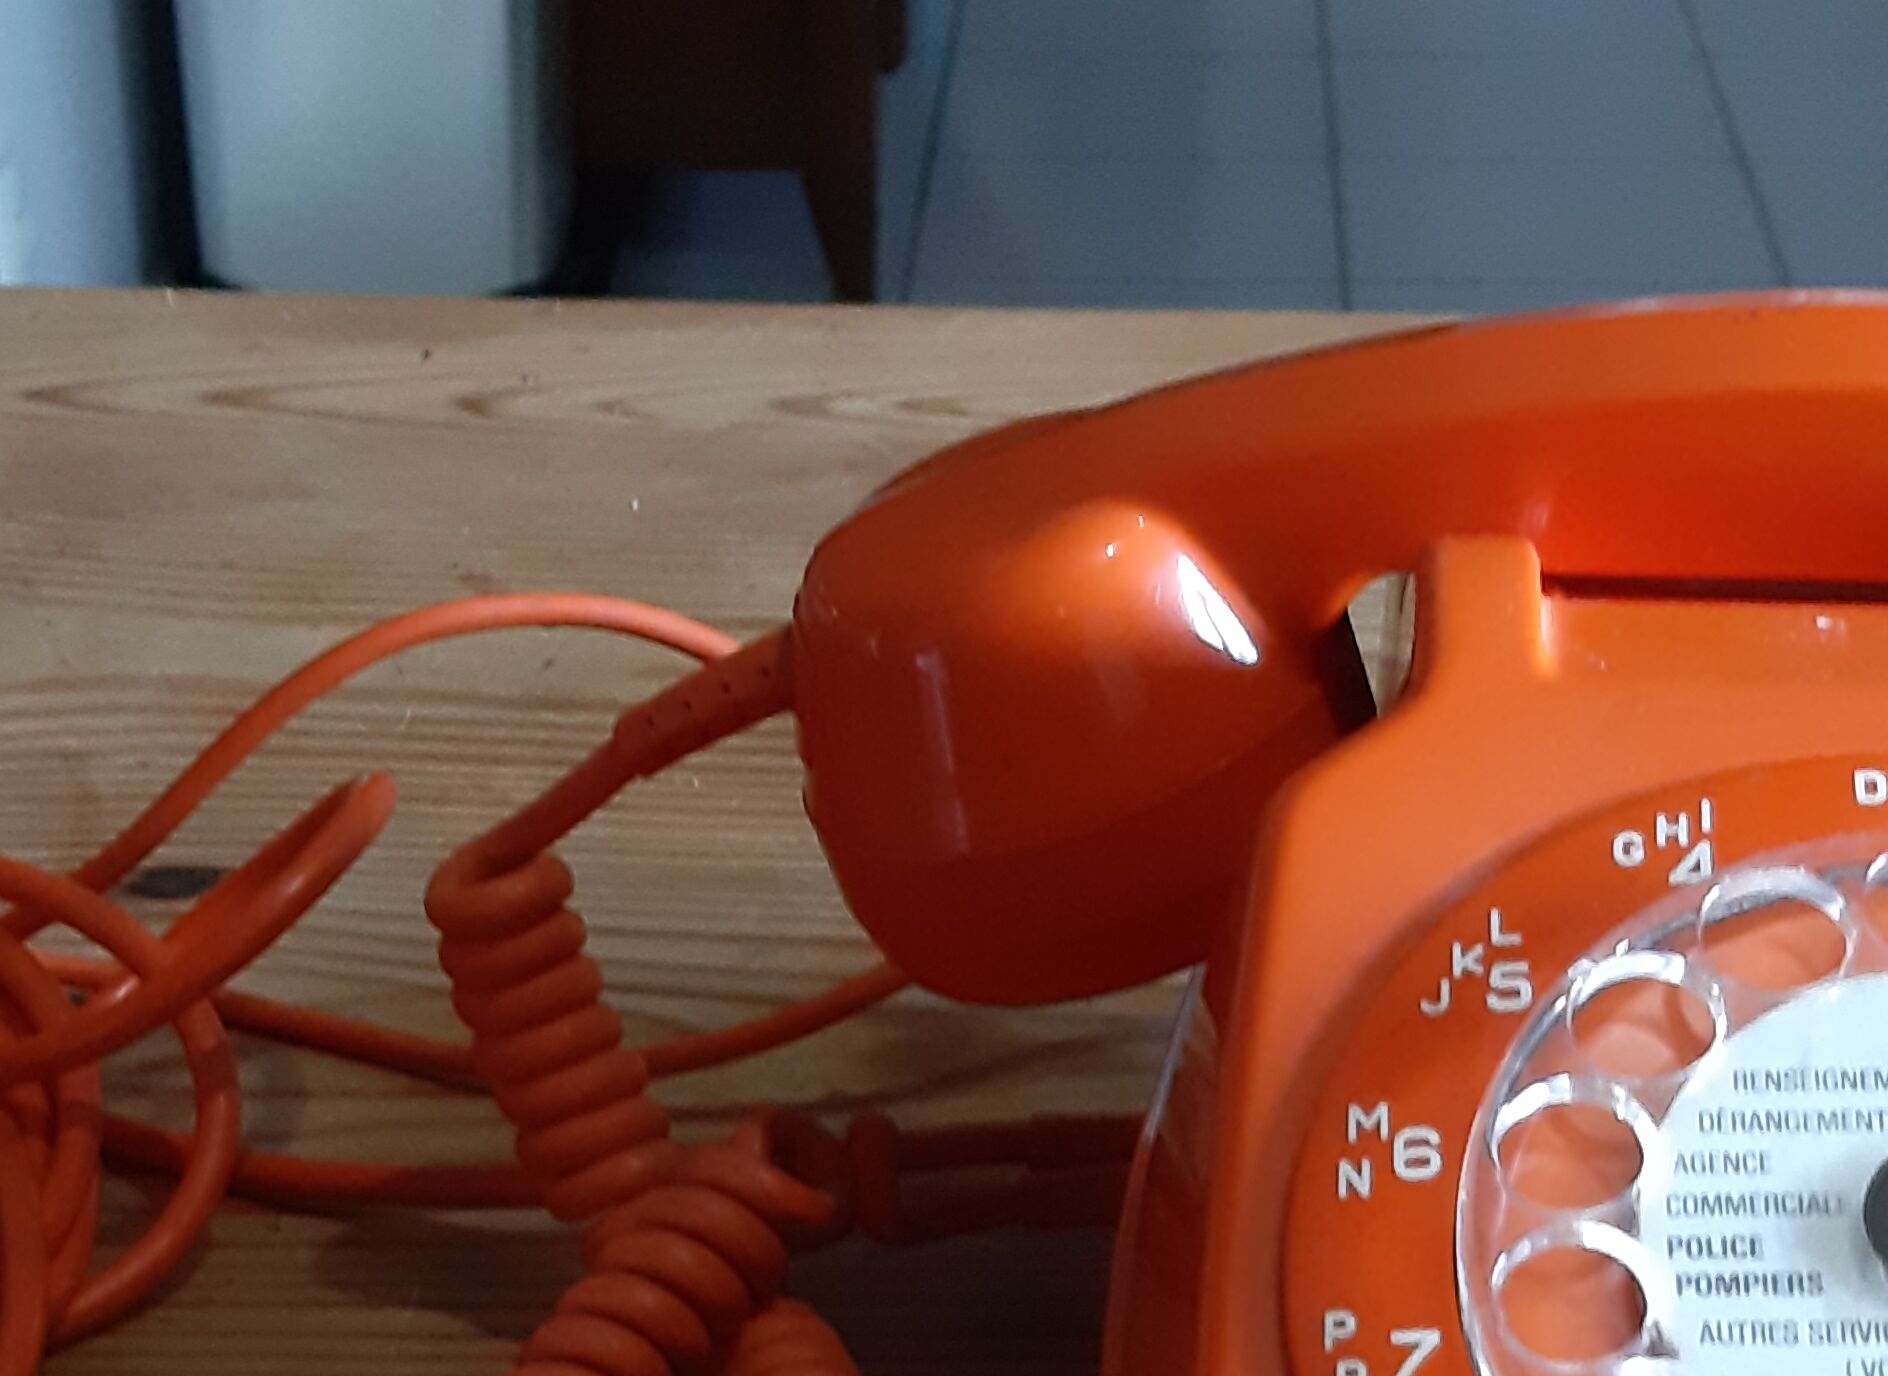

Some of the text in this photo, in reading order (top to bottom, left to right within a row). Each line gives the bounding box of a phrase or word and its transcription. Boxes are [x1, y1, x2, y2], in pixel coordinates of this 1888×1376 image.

[1613, 797, 1715, 868] GHI
[1668, 839, 1713, 885] 4
[1486, 961, 1534, 1013] 5
[1393, 1125, 1443, 1182] 6
[1674, 1149, 1770, 1175] AGENCE
[1666, 1233, 1762, 1259] POLICE
[1675, 1269, 1824, 1297] POMPIERS
[1699, 1319, 1799, 1345] AUTRES
